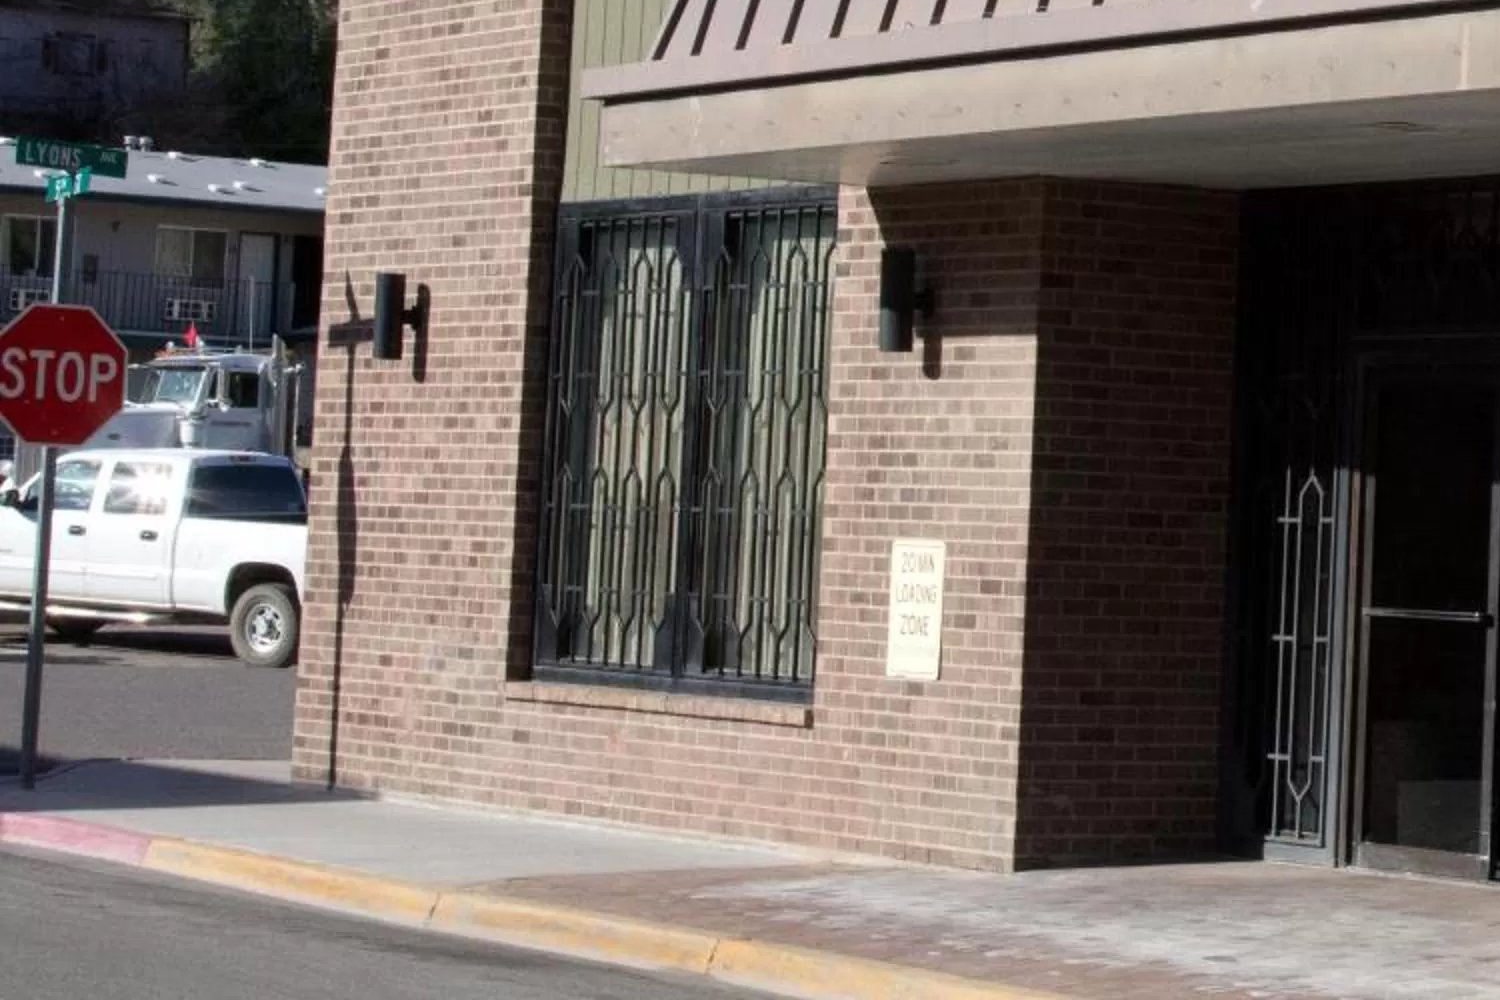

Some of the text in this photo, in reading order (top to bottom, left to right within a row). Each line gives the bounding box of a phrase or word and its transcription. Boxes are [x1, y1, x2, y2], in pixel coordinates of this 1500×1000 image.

[25, 141, 84, 169] LYONS
[0, 346, 118, 403] STOP
[896, 583, 938, 604] LOADING
[899, 614, 931, 637] ZONE
